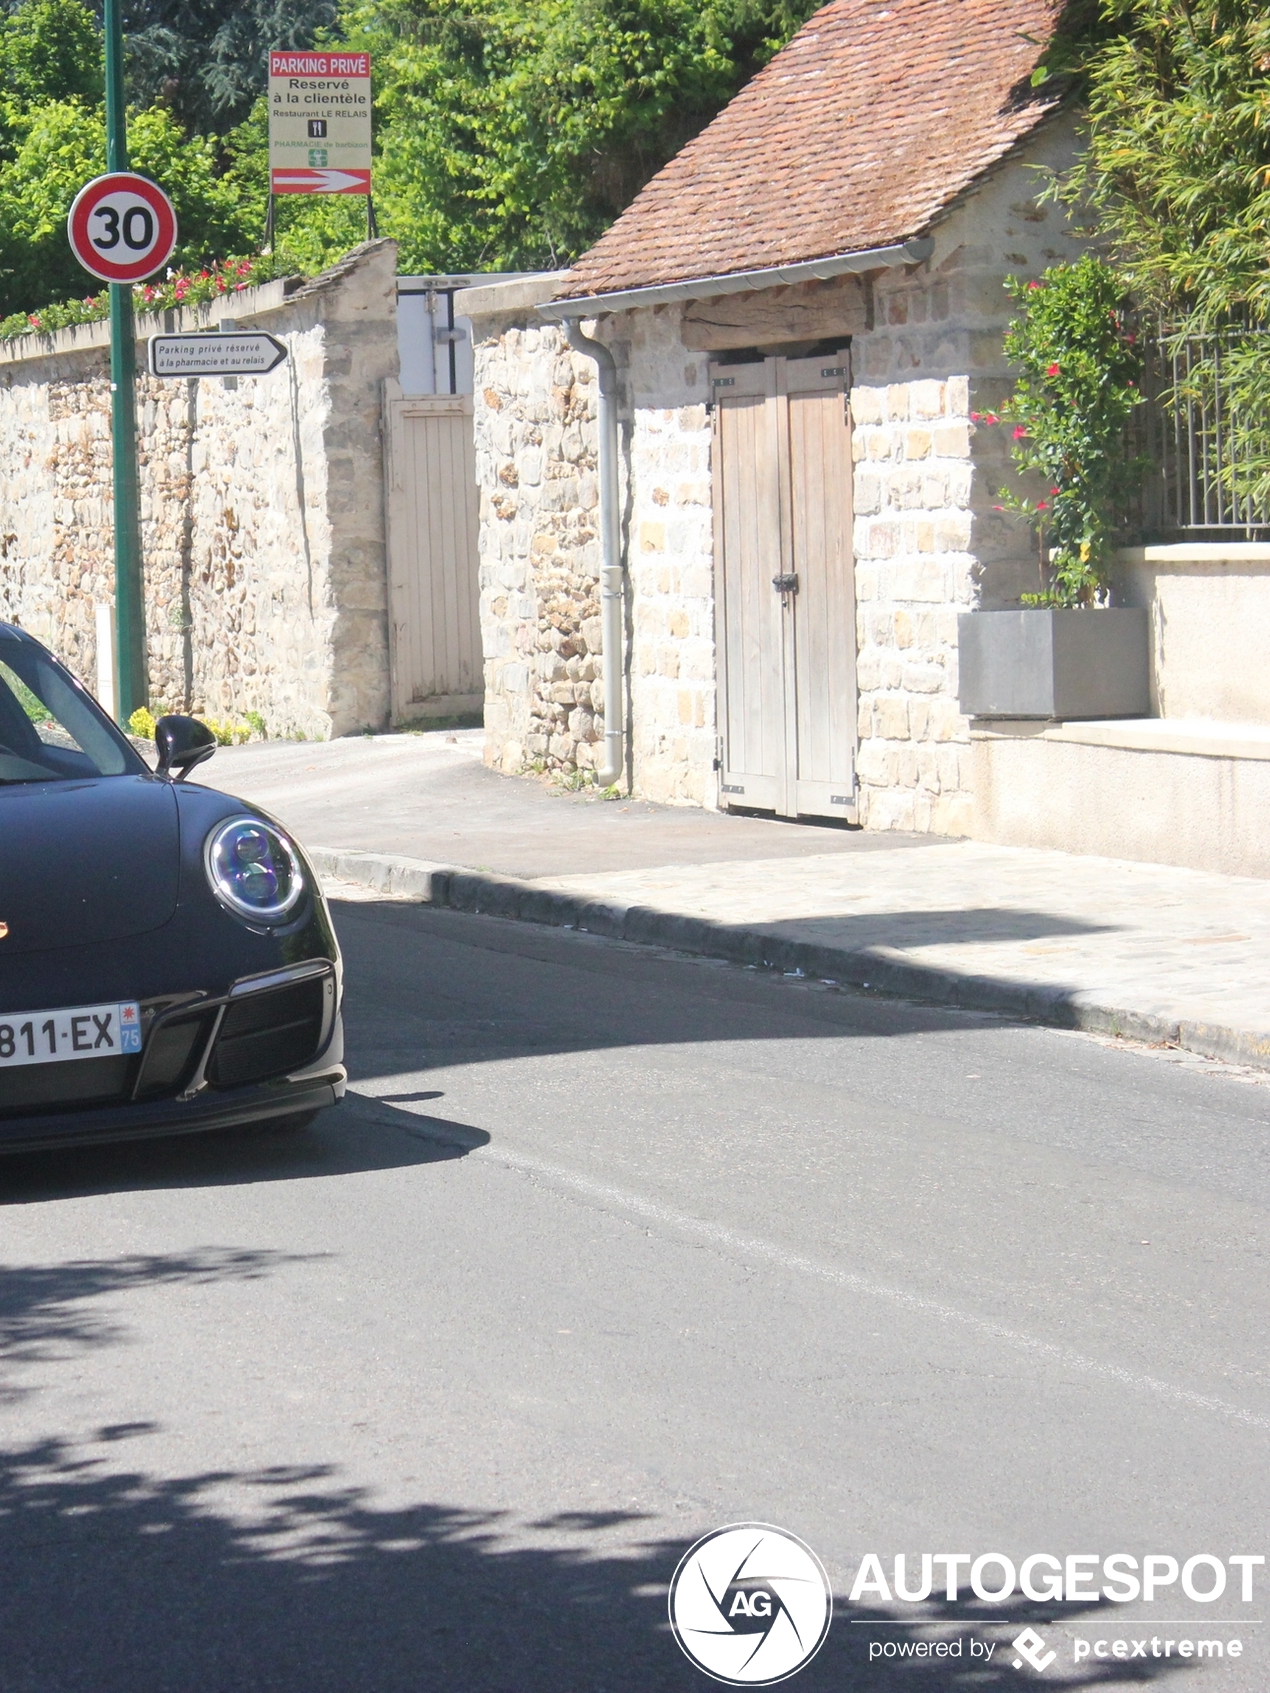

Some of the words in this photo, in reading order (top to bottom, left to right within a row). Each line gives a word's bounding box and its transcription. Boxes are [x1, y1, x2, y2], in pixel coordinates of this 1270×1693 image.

[272, 58, 327, 73] PARKING
[330, 55, 366, 74] PRIVÉ
[289, 78, 350, 90] Reservé
[273, 92, 282, 103] à
[286, 92, 299, 103] la
[303, 93, 366, 104] clientèle
[272, 109, 320, 117] Restaurant
[321, 110, 332, 118] LE
[335, 110, 368, 118] RELAIS
[274, 140, 322, 148] PHARMACIE
[92, 206, 154, 251] 30
[158, 345, 195, 355] Parking
[198, 343, 222, 355] privé
[225, 343, 260, 353] réservé
[159, 358, 165, 367] à
[166, 358, 174, 367] la
[175, 356, 218, 369] pharmacie
[220, 357, 229, 366] et
[231, 357, 240, 365] au
[242, 355, 265, 365] relais
[121, 1029, 139, 1048] 75
